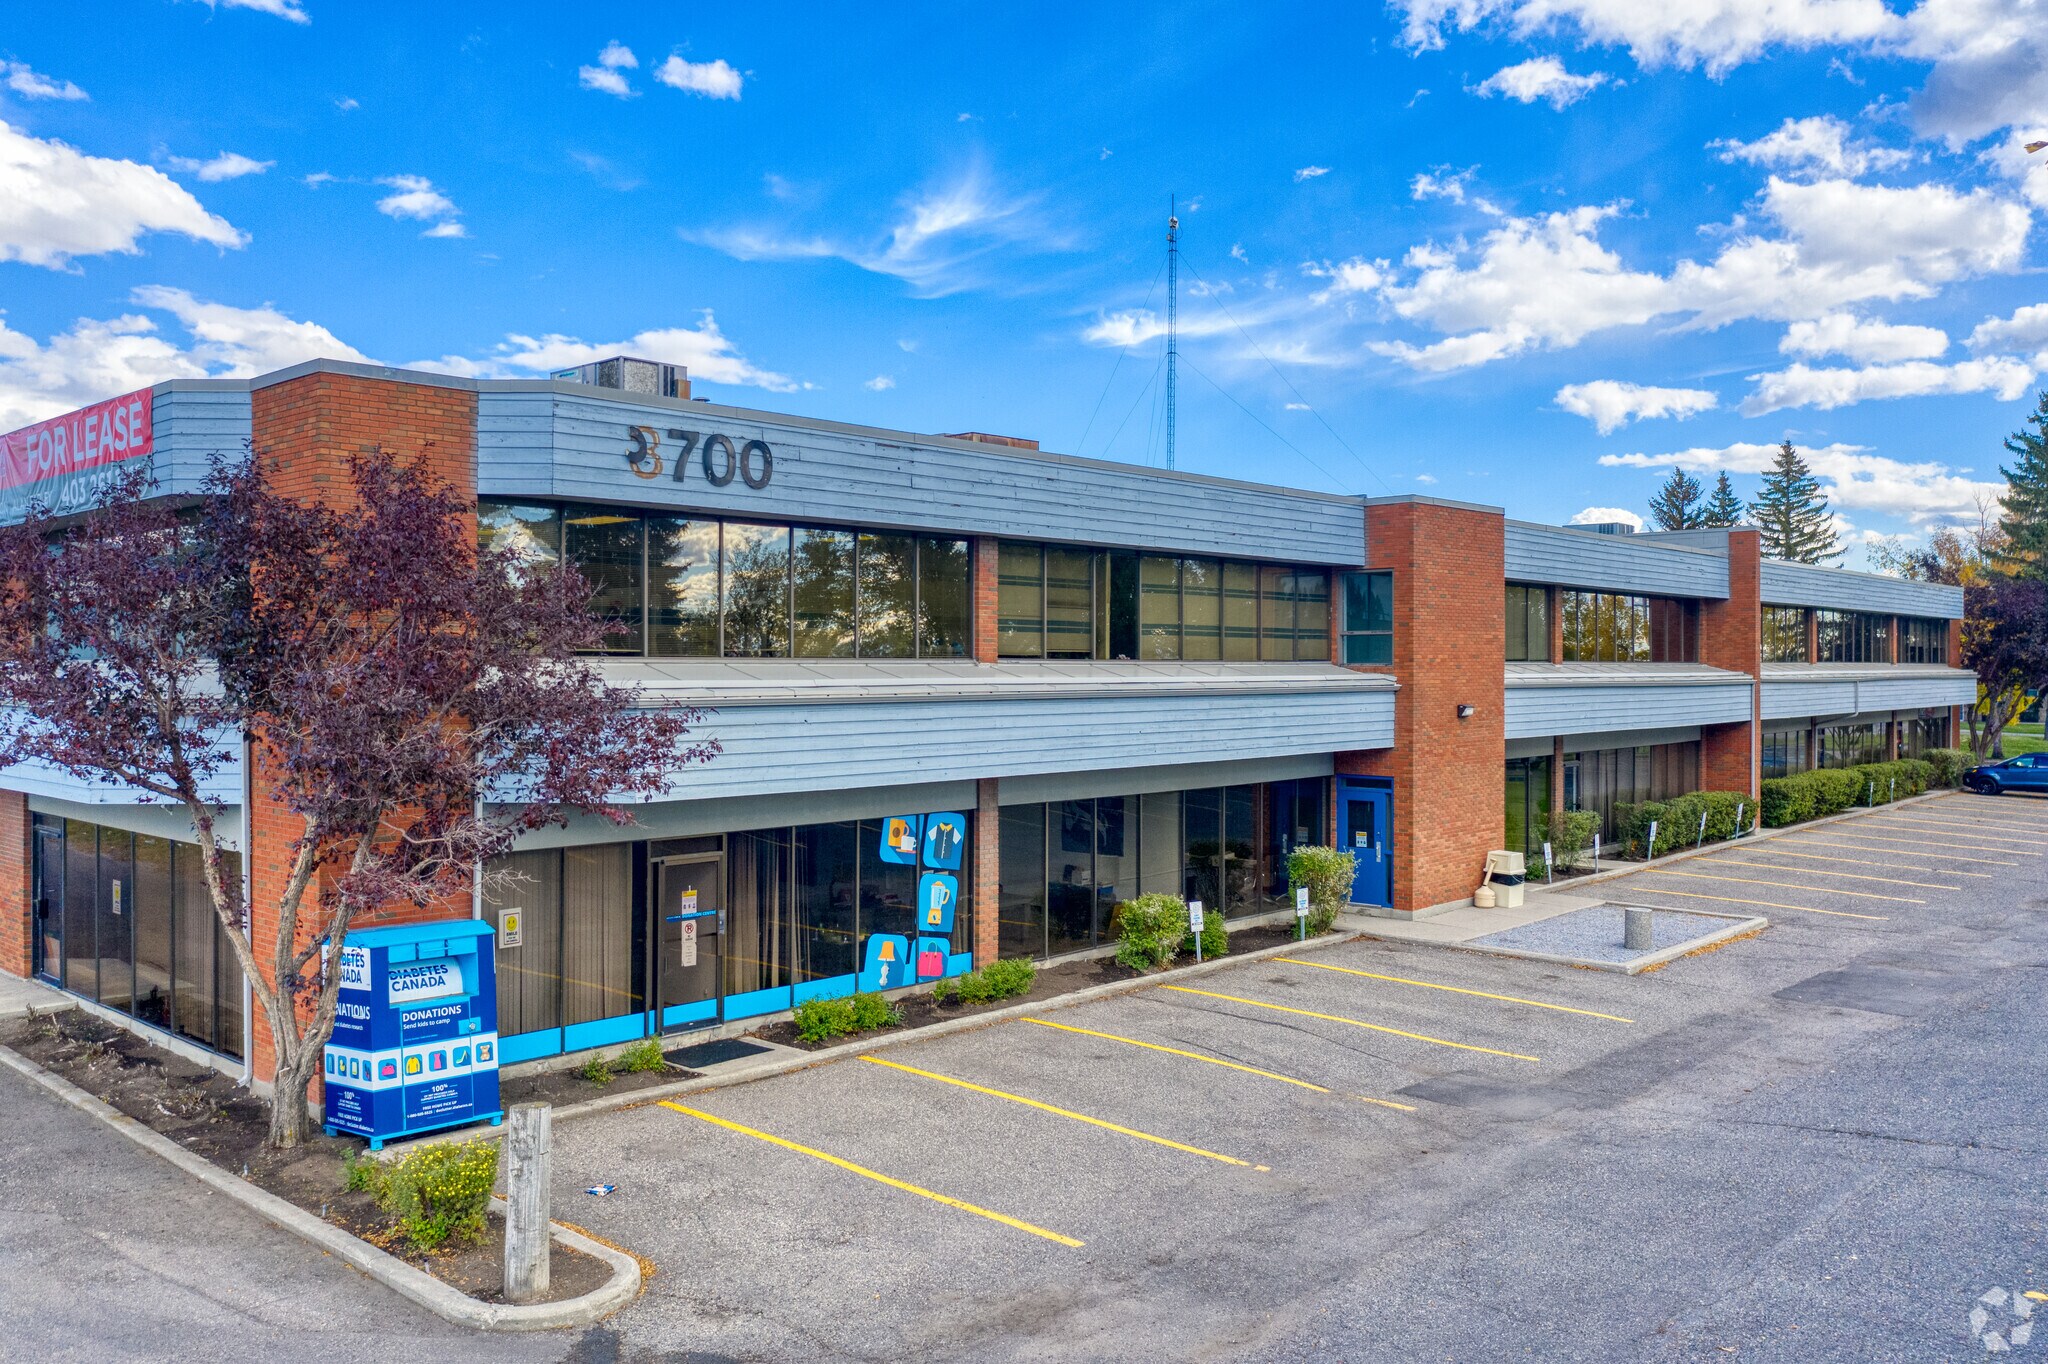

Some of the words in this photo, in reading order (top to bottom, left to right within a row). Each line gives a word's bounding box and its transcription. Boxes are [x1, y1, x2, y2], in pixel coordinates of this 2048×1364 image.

[26, 425, 66, 474] FOR
[73, 401, 144, 463] LEASE
[62, 476, 86, 506] 403
[340, 952, 365, 968] BETES
[340, 968, 362, 984] NADA
[388, 964, 448, 980] DIABETES
[392, 976, 446, 992] CANADA
[336, 1002, 370, 1020] NATIONS
[402, 1005, 462, 1022] DONATIONS
[403, 1022, 416, 1030] Send
[418, 1020, 428, 1028] kids
[436, 1018, 450, 1026] camp
